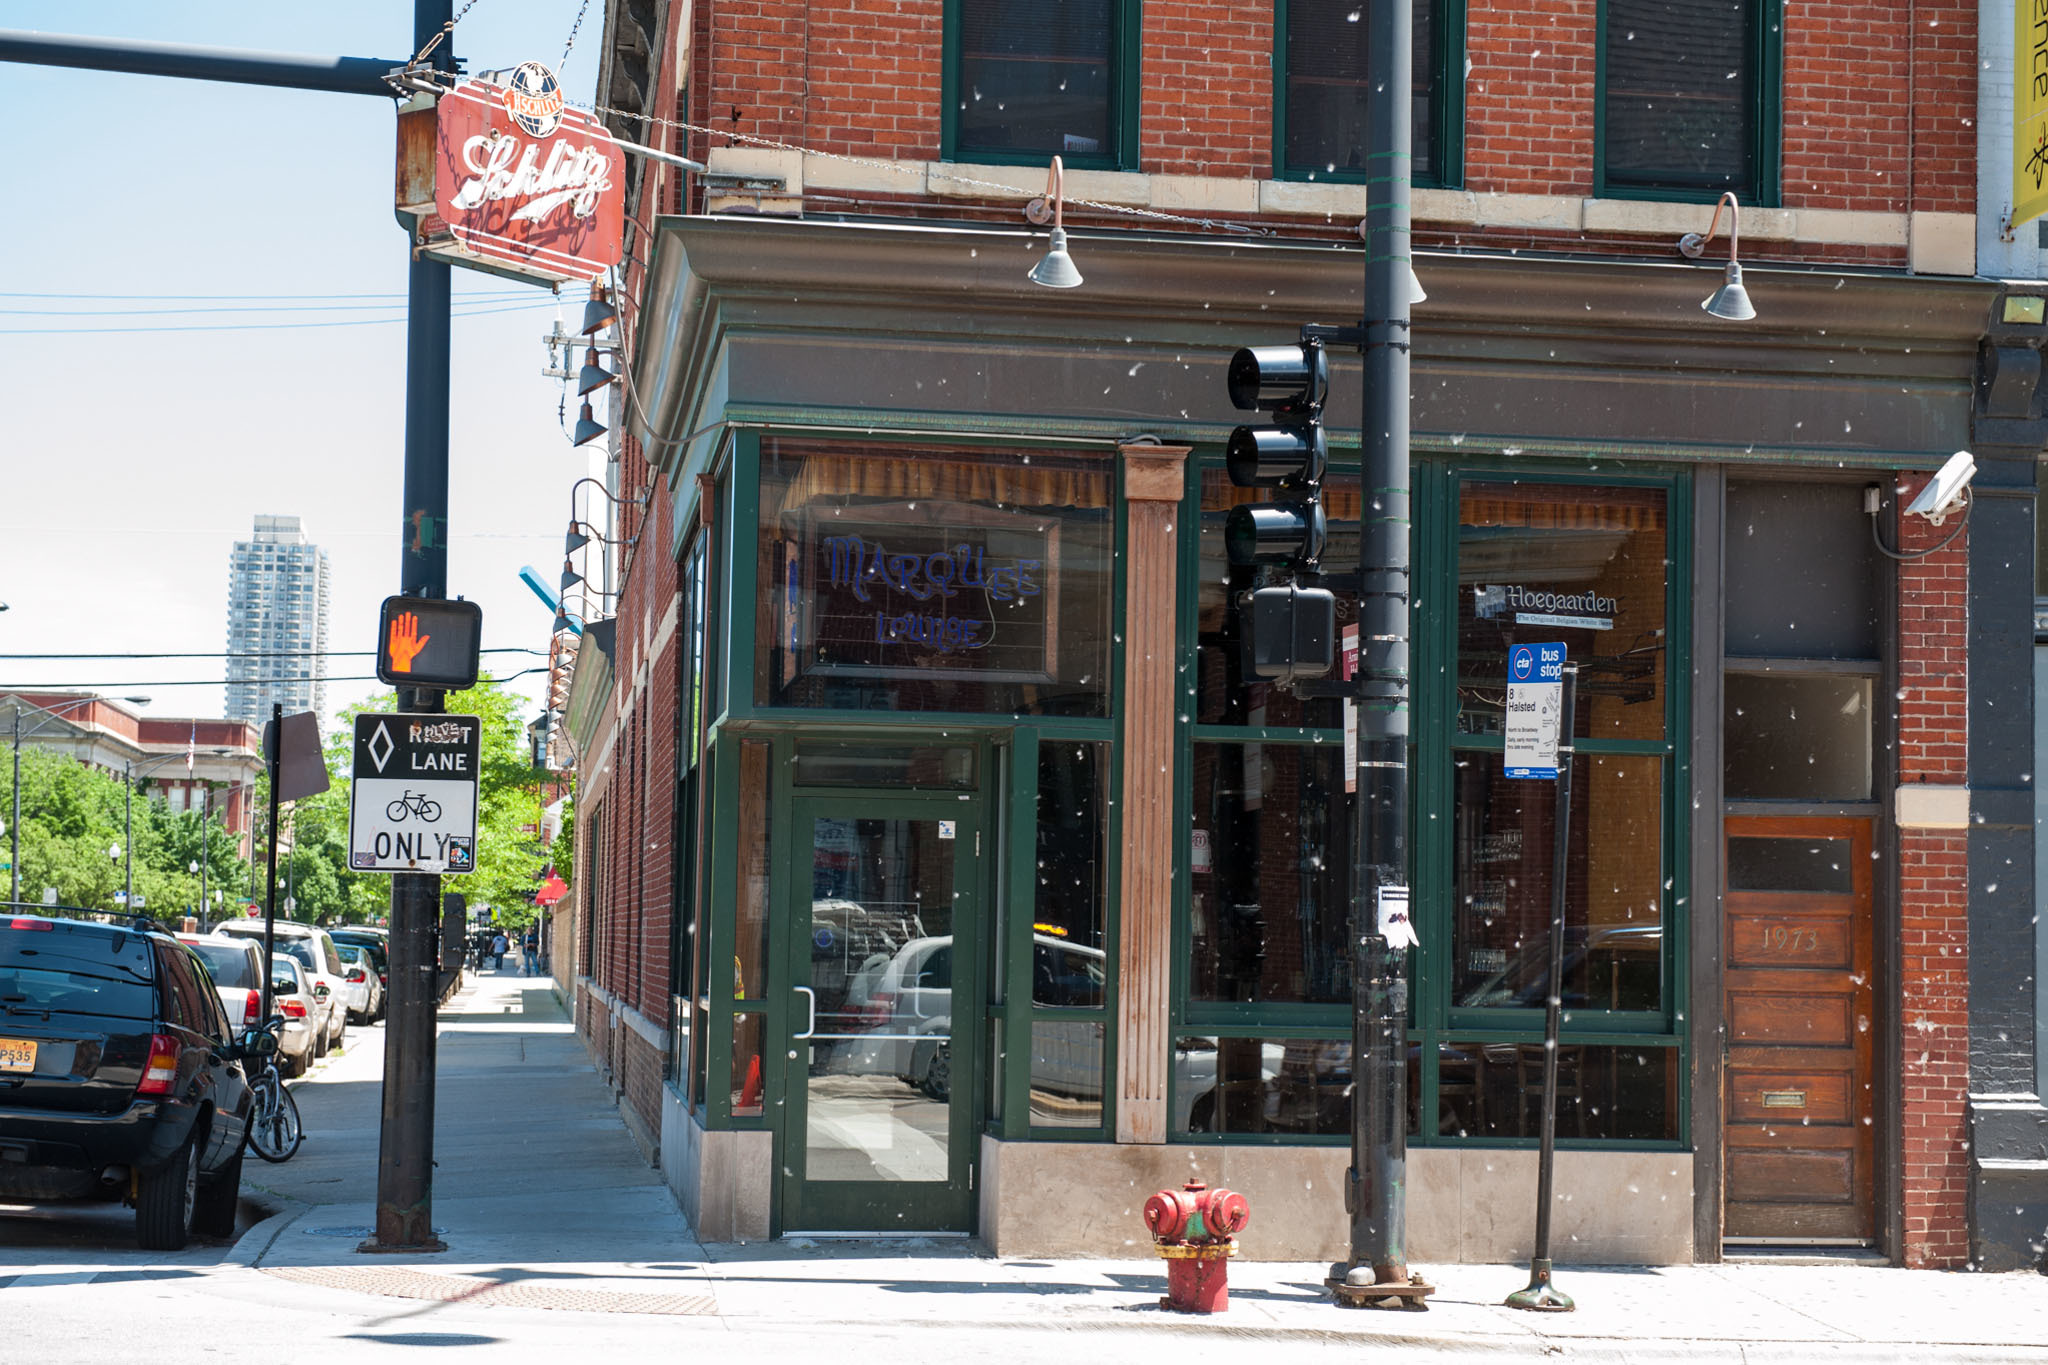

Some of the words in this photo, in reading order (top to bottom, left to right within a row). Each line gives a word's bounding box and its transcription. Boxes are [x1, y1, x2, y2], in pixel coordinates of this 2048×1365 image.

[449, 133, 613, 224] Schlitz
[824, 535, 1041, 600] MARQUEE
[1507, 585, 1619, 613] Hoegaarden
[876, 611, 983, 651] LOUNGE
[1516, 657, 1530, 669] cta
[1540, 647, 1559, 662] bus
[1539, 663, 1562, 681] stop
[1508, 688, 1515, 700] 8
[1508, 701, 1536, 713] Halsted
[411, 752, 468, 771] LANE
[375, 831, 451, 860] ONLY
[1761, 927, 1818, 951] 1973
